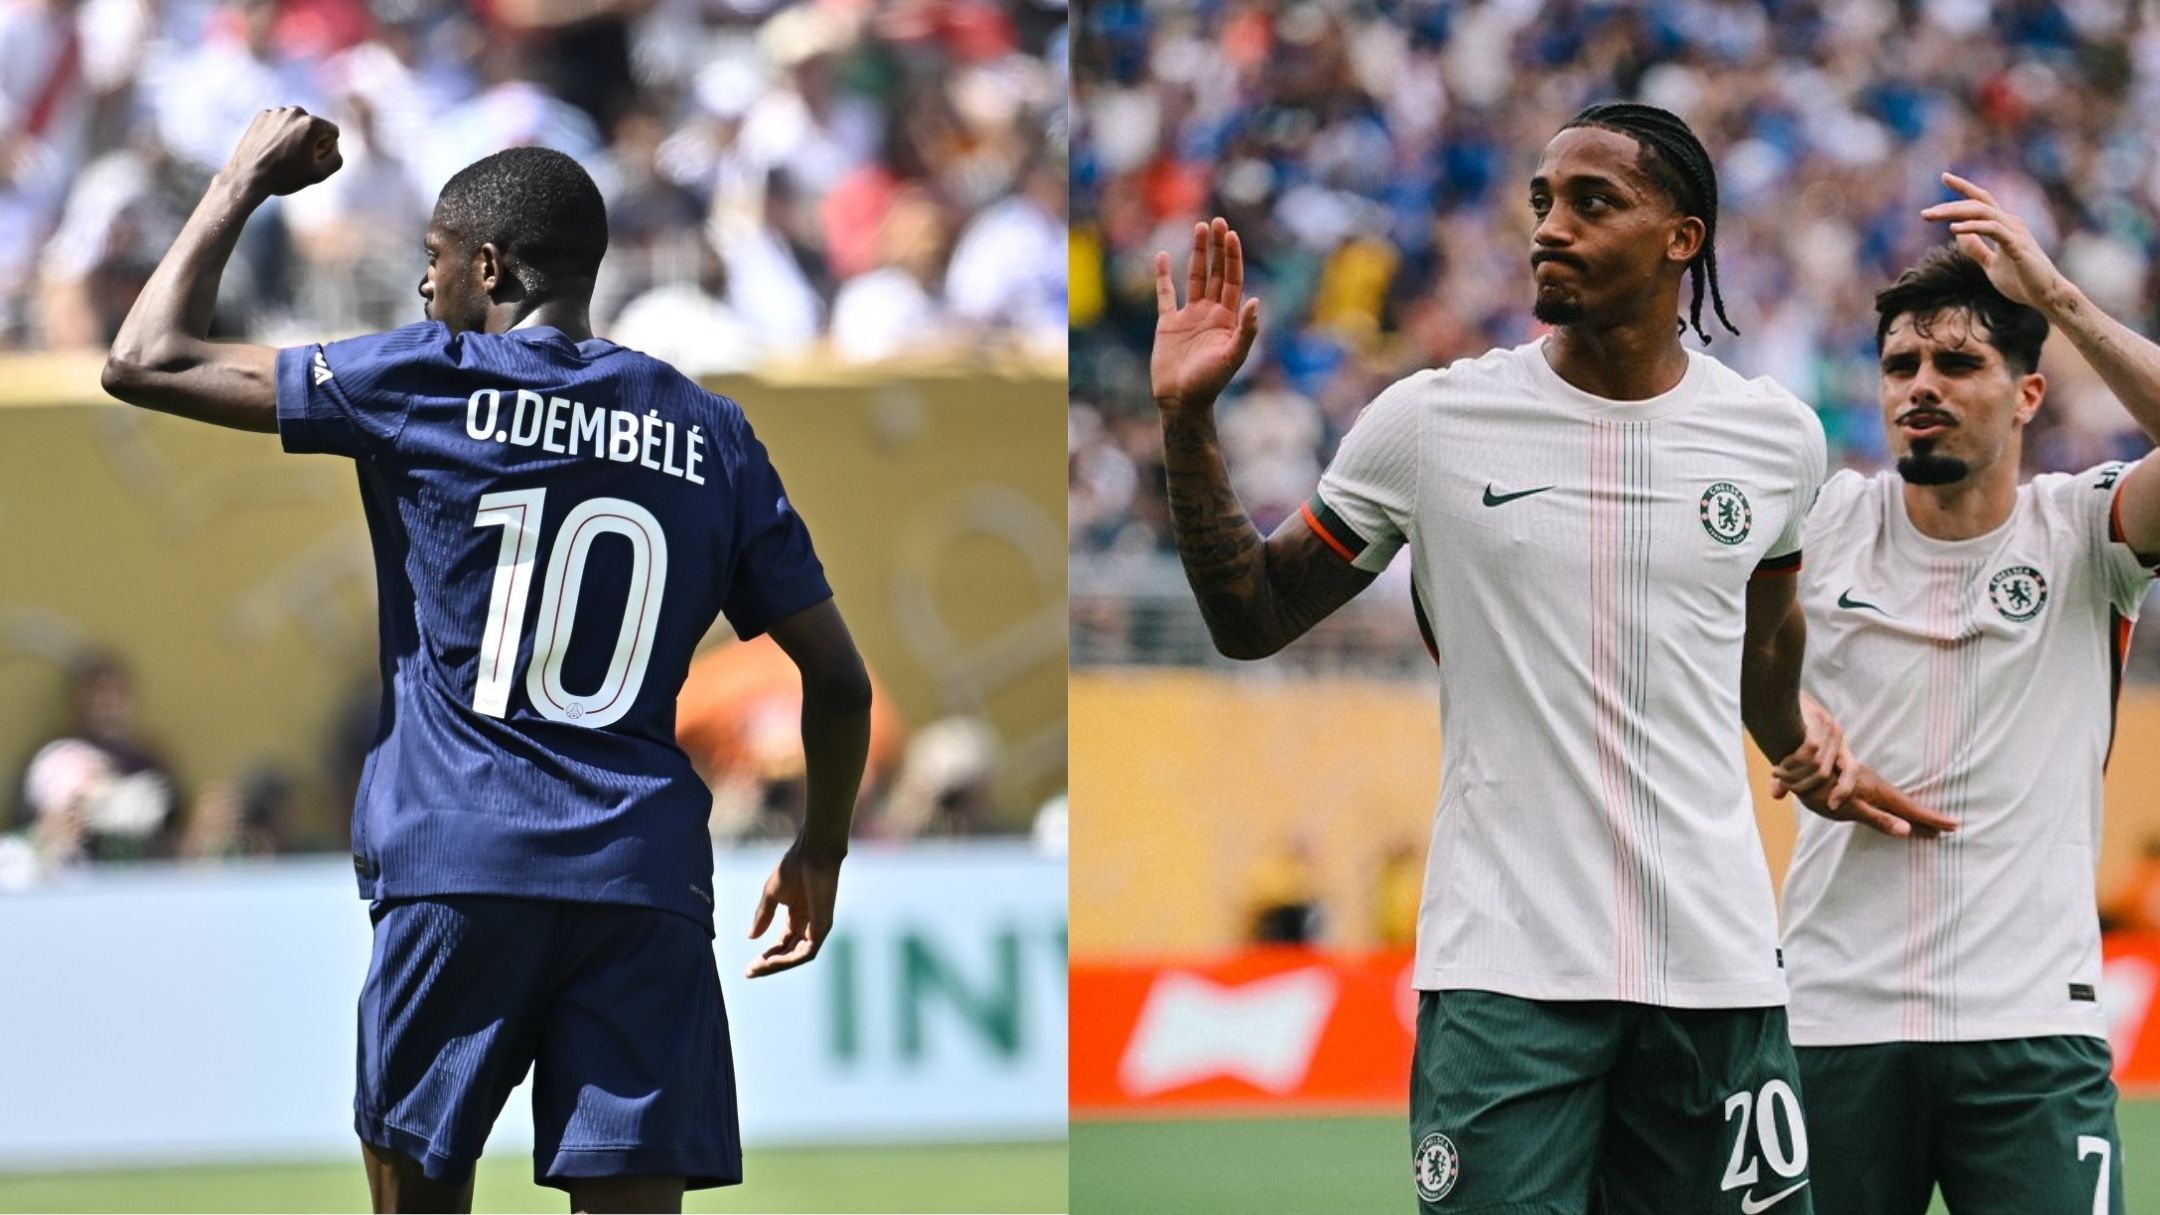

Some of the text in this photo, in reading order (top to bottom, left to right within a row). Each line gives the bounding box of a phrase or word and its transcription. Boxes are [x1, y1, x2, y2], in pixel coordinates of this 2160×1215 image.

[465, 388, 706, 486] O.DEMBÉLÉ
[472, 486, 669, 729] 10
[828, 925, 1068, 1064] IN
[1720, 1078, 1809, 1191] 20
[2077, 1135, 2111, 1215] 7
